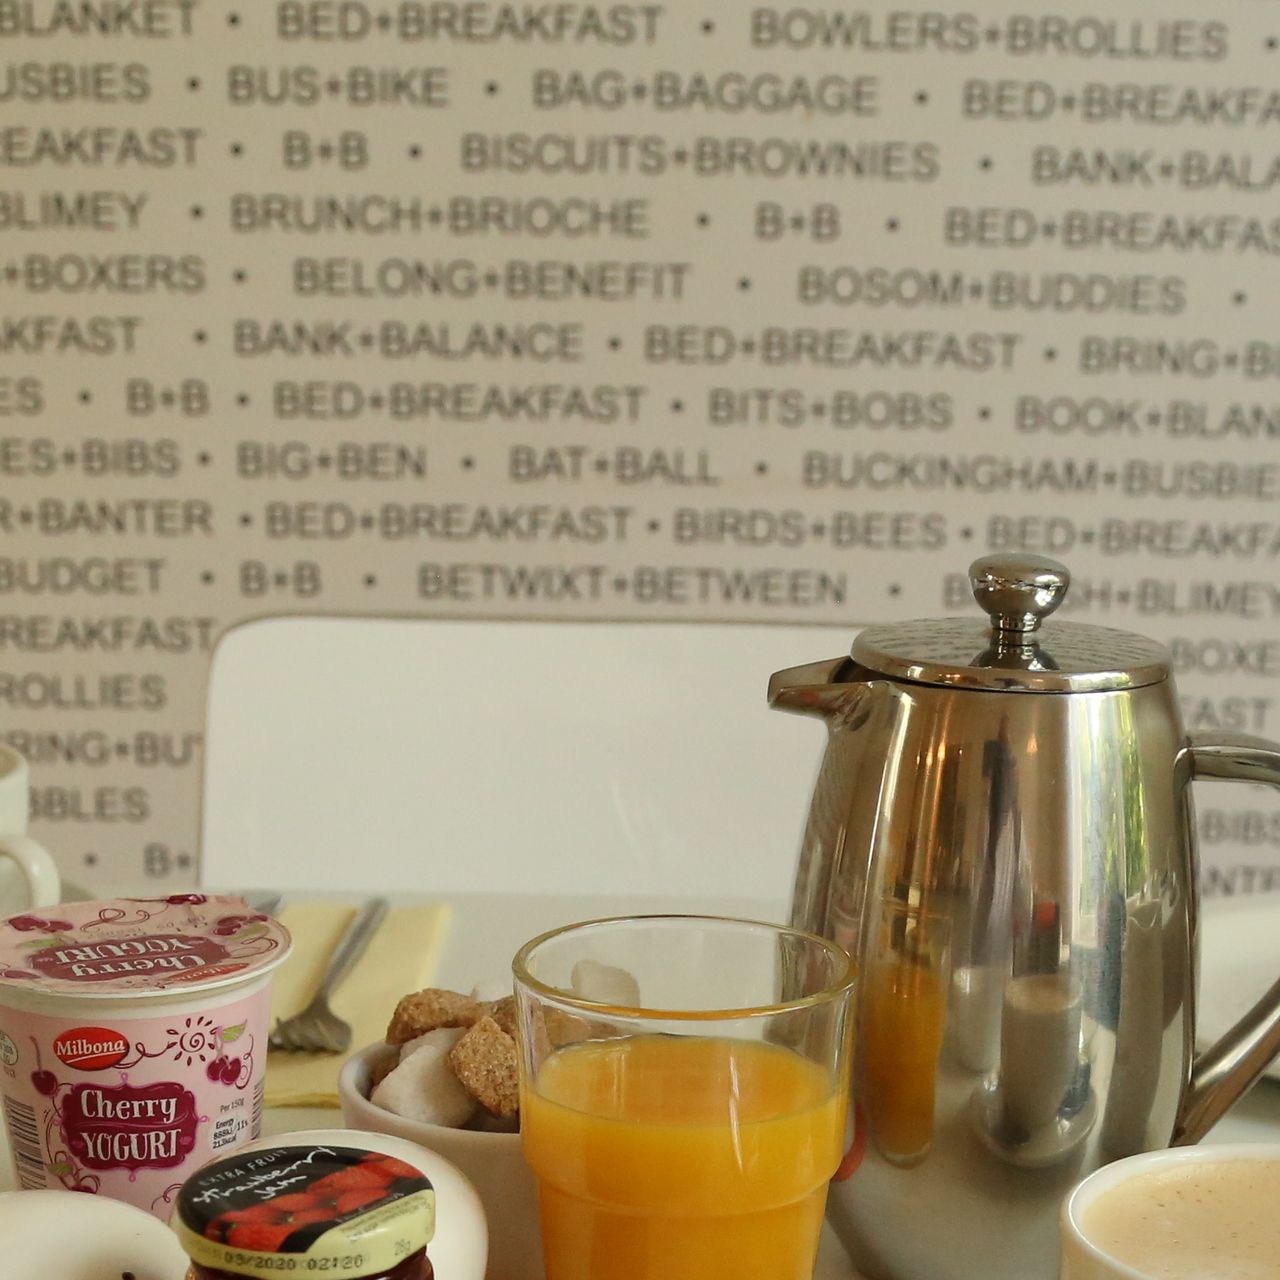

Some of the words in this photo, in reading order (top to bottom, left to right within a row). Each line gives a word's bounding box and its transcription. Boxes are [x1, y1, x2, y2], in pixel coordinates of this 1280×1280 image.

[277, 0, 662, 46] BED+BREAKFAST
[751, 8, 1226, 60] BOWLERS+BROLLIES
[227, 65, 446, 107] BUS+BIKE
[532, 69, 873, 115] BAG+BAGGAGE
[282, 130, 369, 171] B+B
[755, 202, 840, 243] B+B
[293, 258, 688, 300] BELONG+BENEFIT
[233, 319, 579, 362] BANK+BALANCE
[644, 326, 1019, 371] BED+BREAKFAST
[125, 378, 210, 417] B+B
[273, 381, 644, 423] BED+BREAKFAST
[265, 502, 631, 543] BED+BREAKFAST
[239, 560, 322, 598] B+B
[56, 1036, 125, 1057] Milbona
[80, 1089, 177, 1125] Cherry
[81, 1128, 181, 1162] YOGURT
[197, 1167, 246, 1187] EXTRA
[246, 1149, 288, 1171] FRUIT
